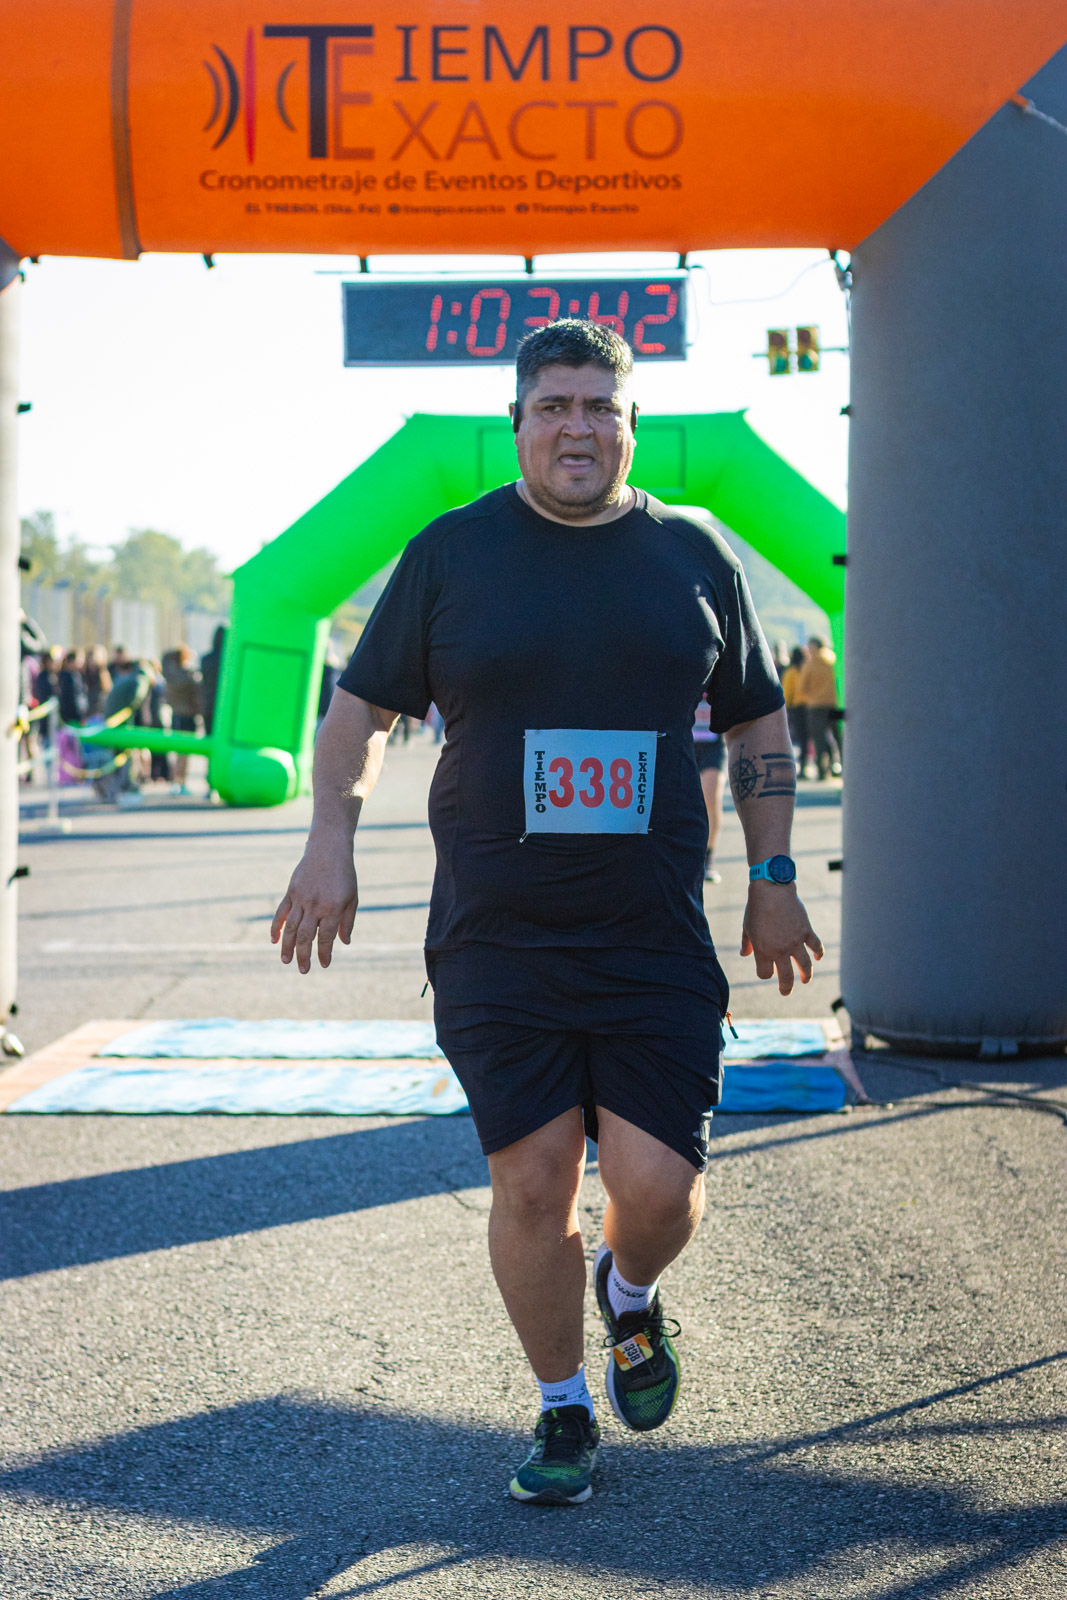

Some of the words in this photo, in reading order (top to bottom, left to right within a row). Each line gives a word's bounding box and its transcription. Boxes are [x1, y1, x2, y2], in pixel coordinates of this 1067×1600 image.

[199, 169, 377, 195] Cronometraje
[384, 170, 417, 191] de
[424, 170, 528, 191] Eventos
[535, 169, 683, 195] Deportivos
[534, 750, 547, 814] TIEMPO
[548, 756, 634, 809] 338
[636, 751, 648, 815] EXACTO
[624, 1343, 642, 1363] 338
